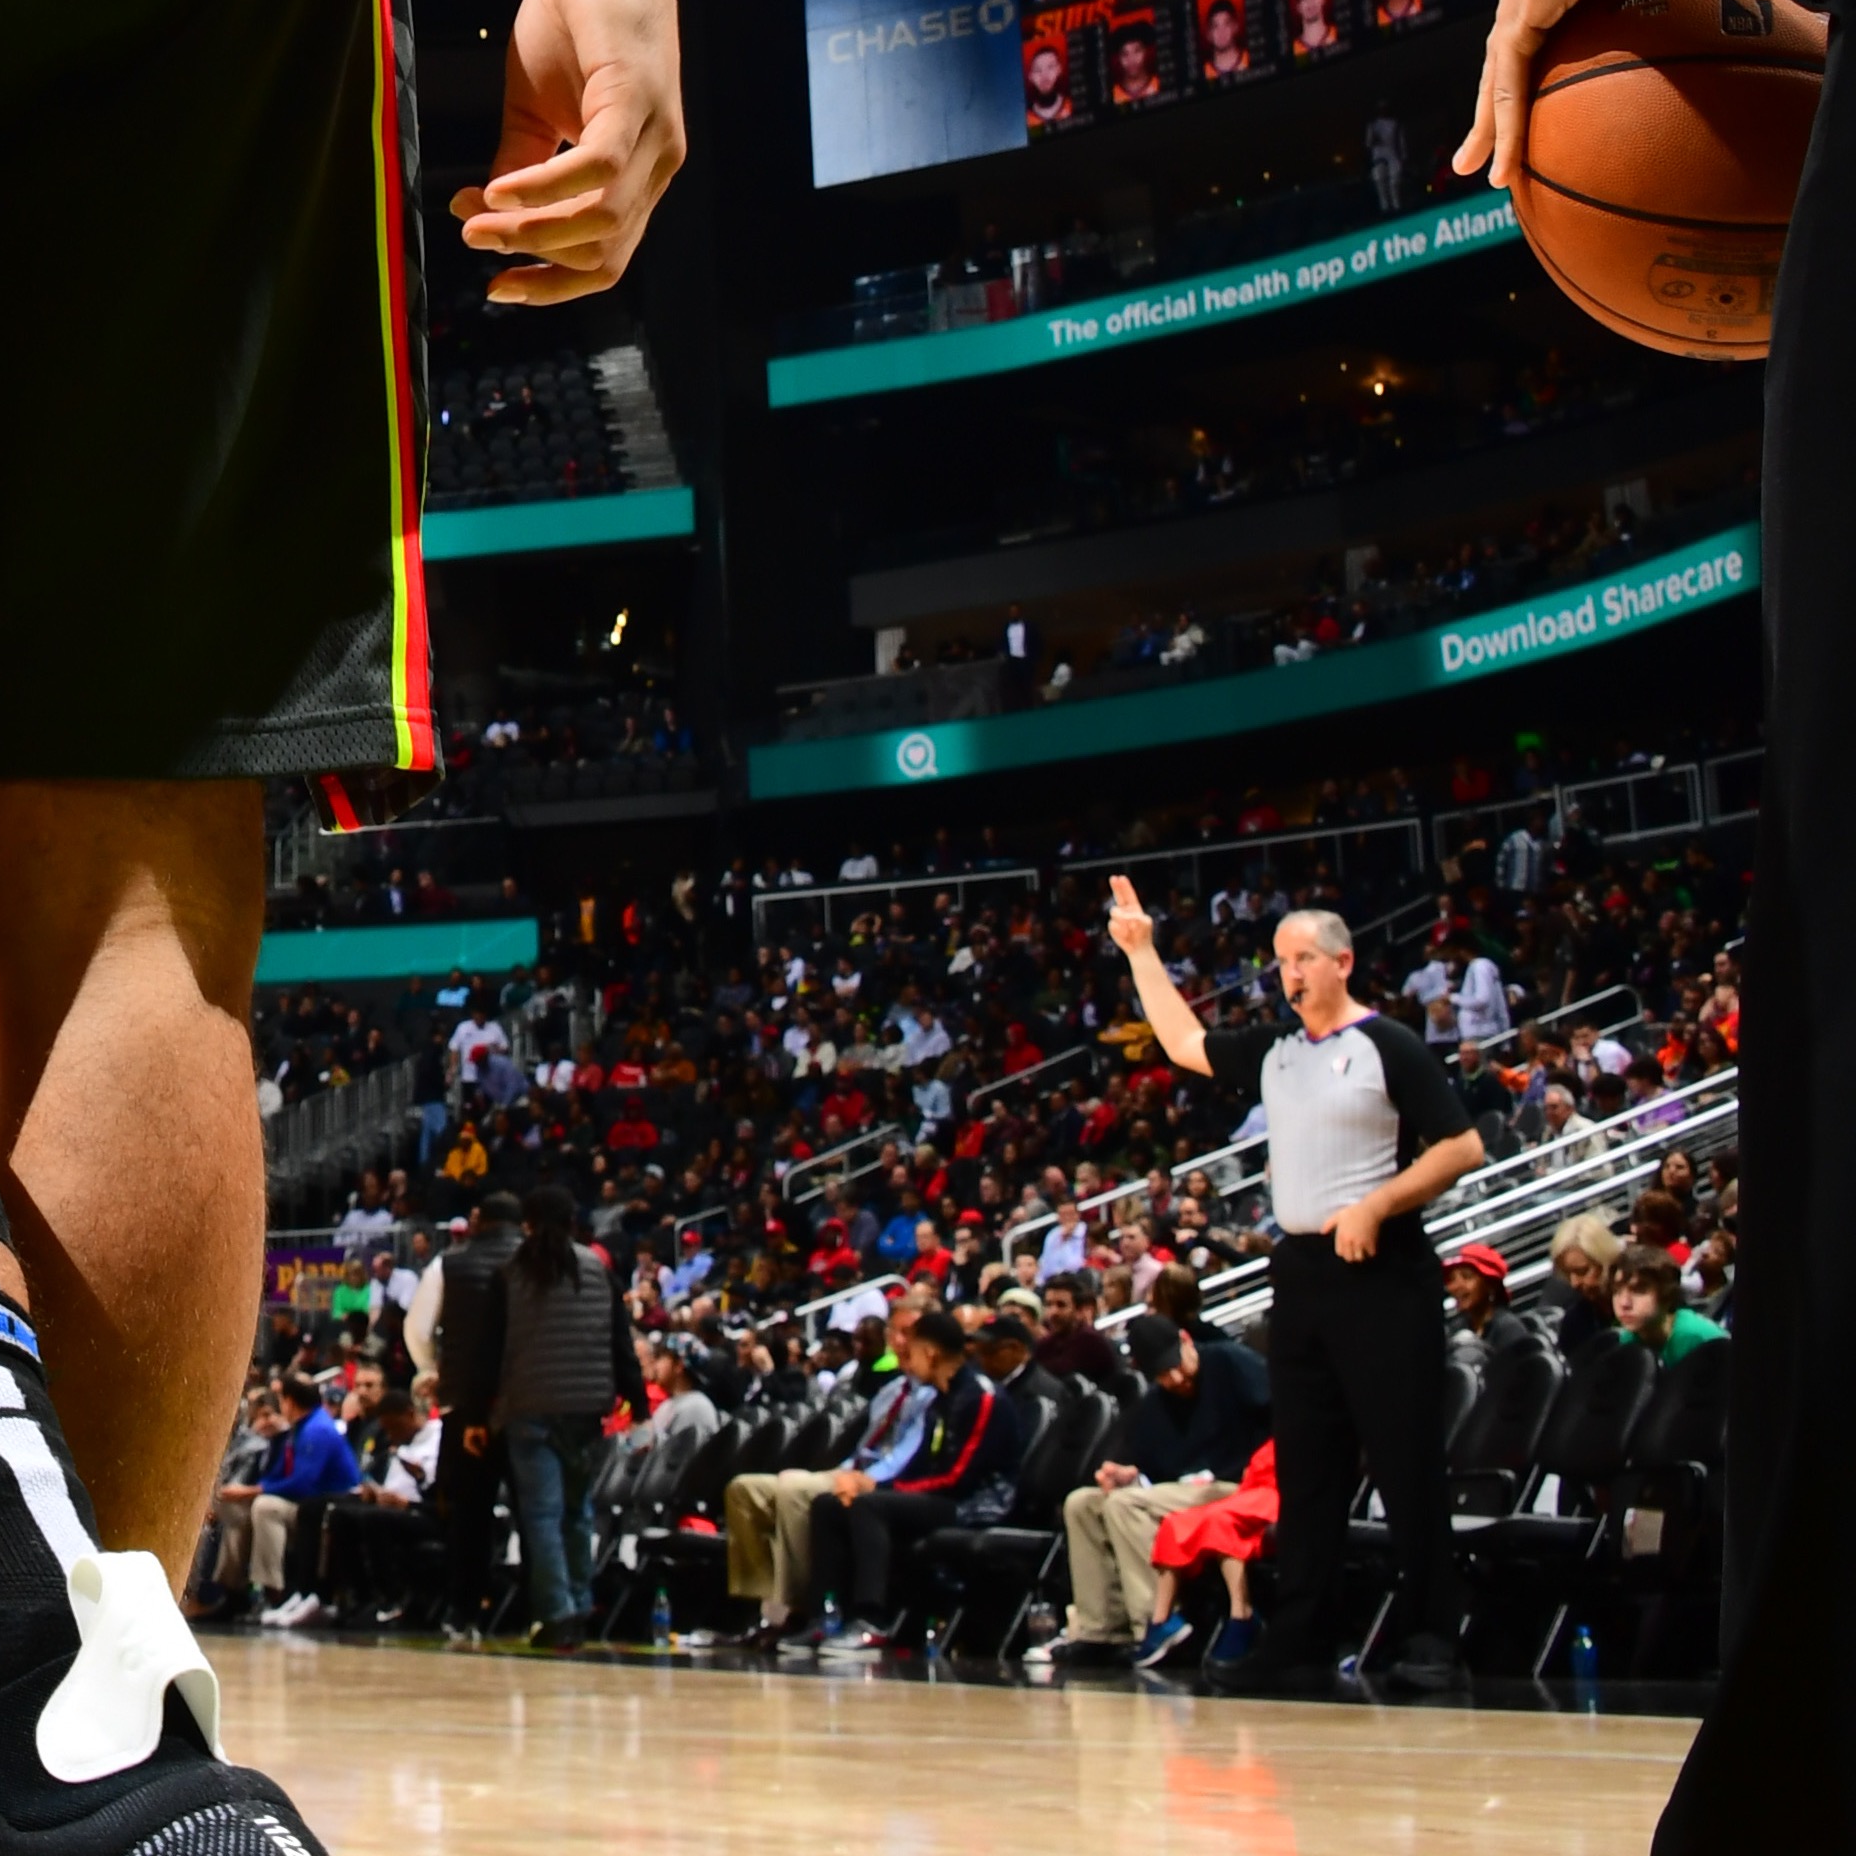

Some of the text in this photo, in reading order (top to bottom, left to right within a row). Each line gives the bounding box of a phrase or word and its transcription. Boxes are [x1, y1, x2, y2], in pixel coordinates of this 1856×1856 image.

[827, 4, 973, 63] CHASE
[1048, 316, 1099, 347] The
[1105, 292, 1197, 336] official
[1204, 269, 1291, 313] health
[1296, 257, 1345, 292] app
[1351, 240, 1380, 274] of
[1384, 230, 1427, 263] the
[1440, 550, 1743, 672] Download Sharecare
